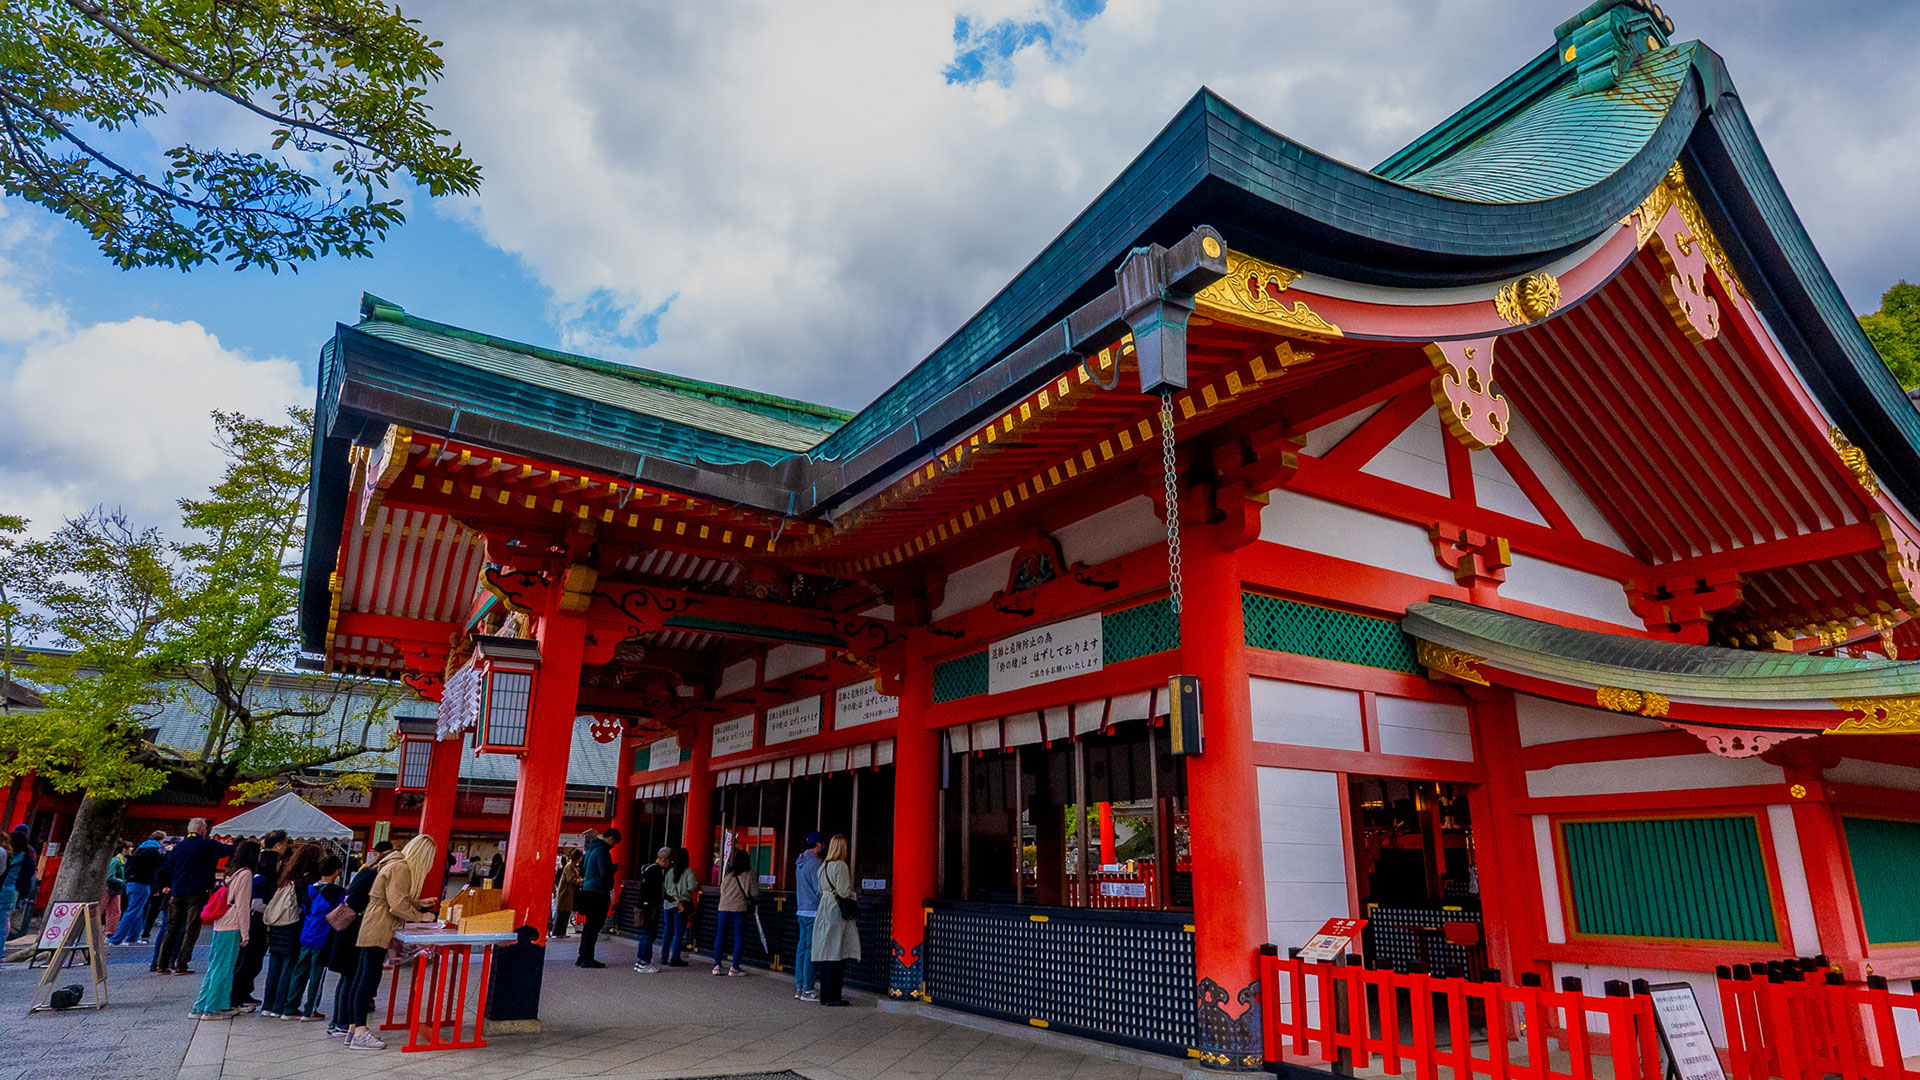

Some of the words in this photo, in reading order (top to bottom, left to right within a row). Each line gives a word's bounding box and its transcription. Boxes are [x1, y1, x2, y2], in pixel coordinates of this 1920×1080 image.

[1033, 638, 1099, 662] はずしております
